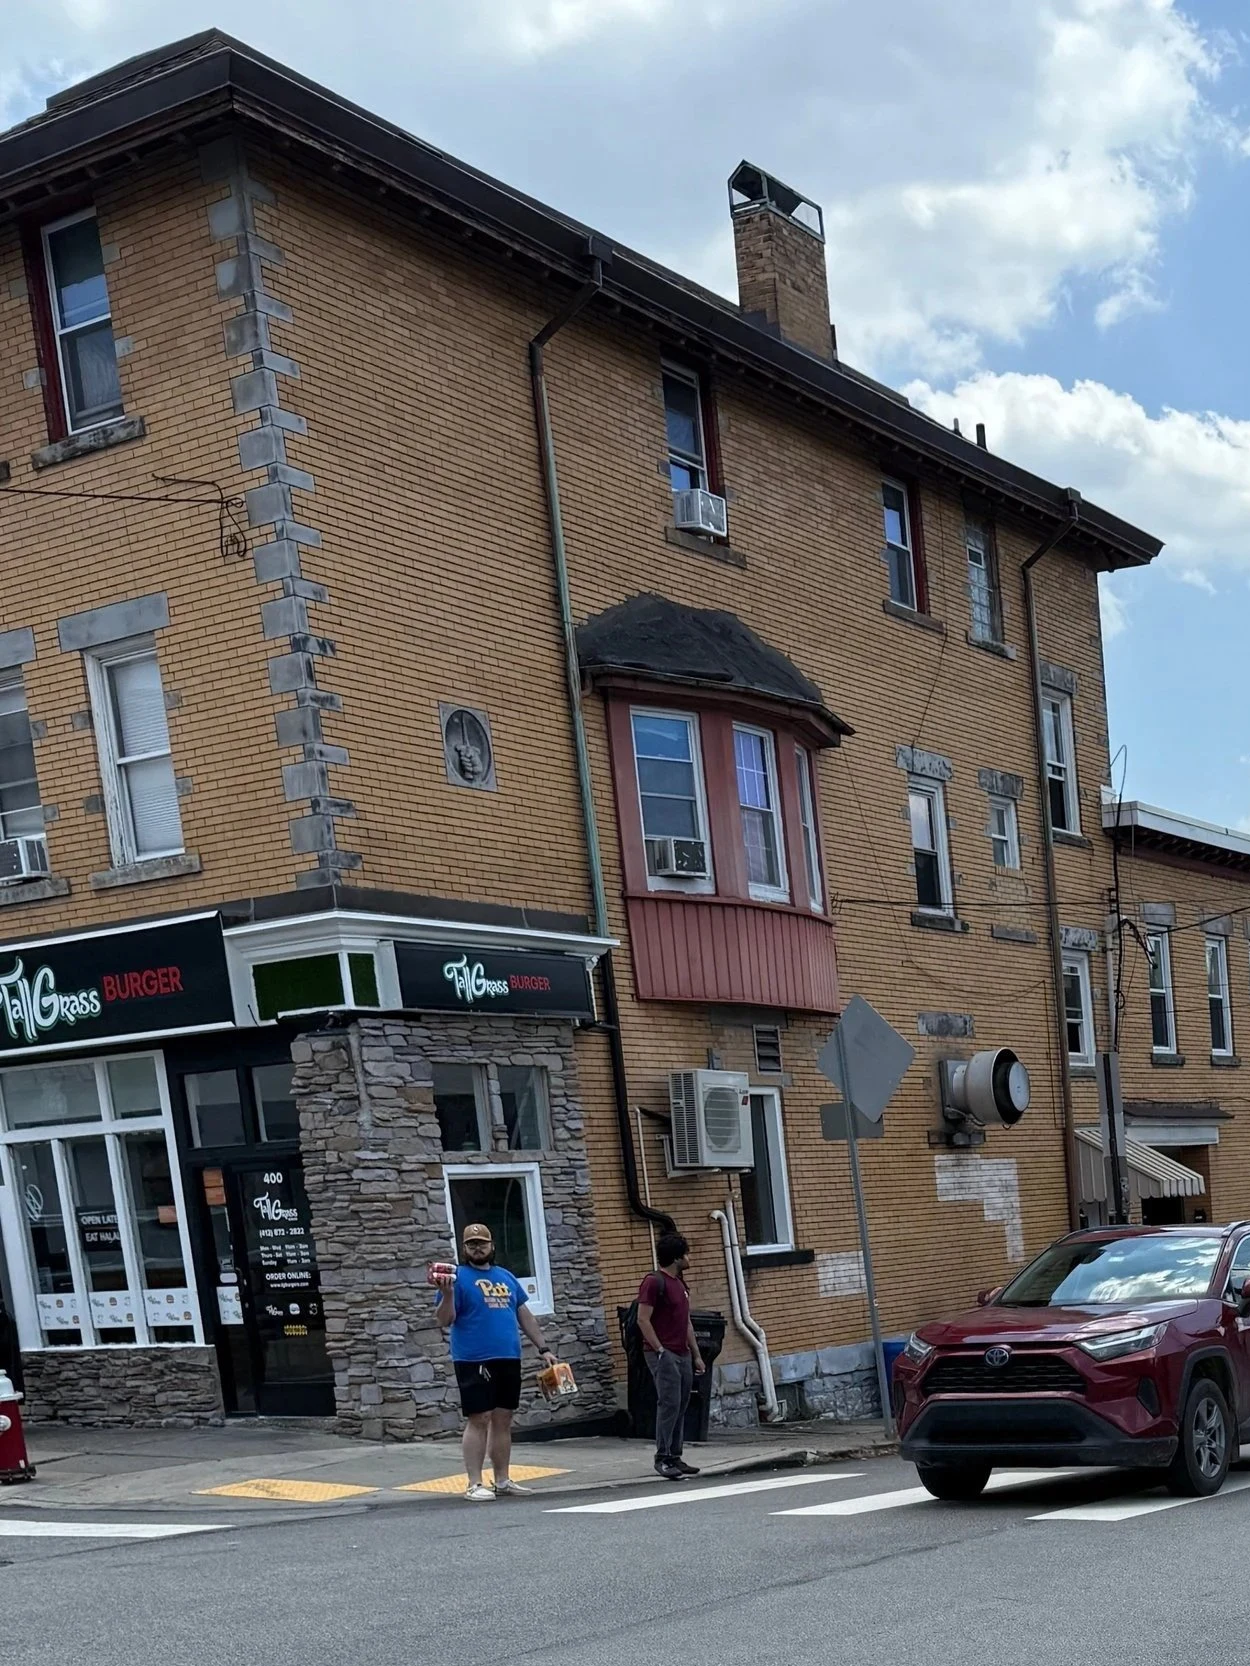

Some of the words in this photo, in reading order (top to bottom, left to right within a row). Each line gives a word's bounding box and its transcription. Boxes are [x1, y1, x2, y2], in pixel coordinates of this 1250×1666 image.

[103, 966, 184, 1003] BURGER
[509, 974, 551, 991] BURGER
[263, 1172, 283, 1185] 400
[80, 1215, 101, 1225] OPEN
[85, 1232, 98, 1242] EAT
[265, 1272, 287, 1281] ORDER
